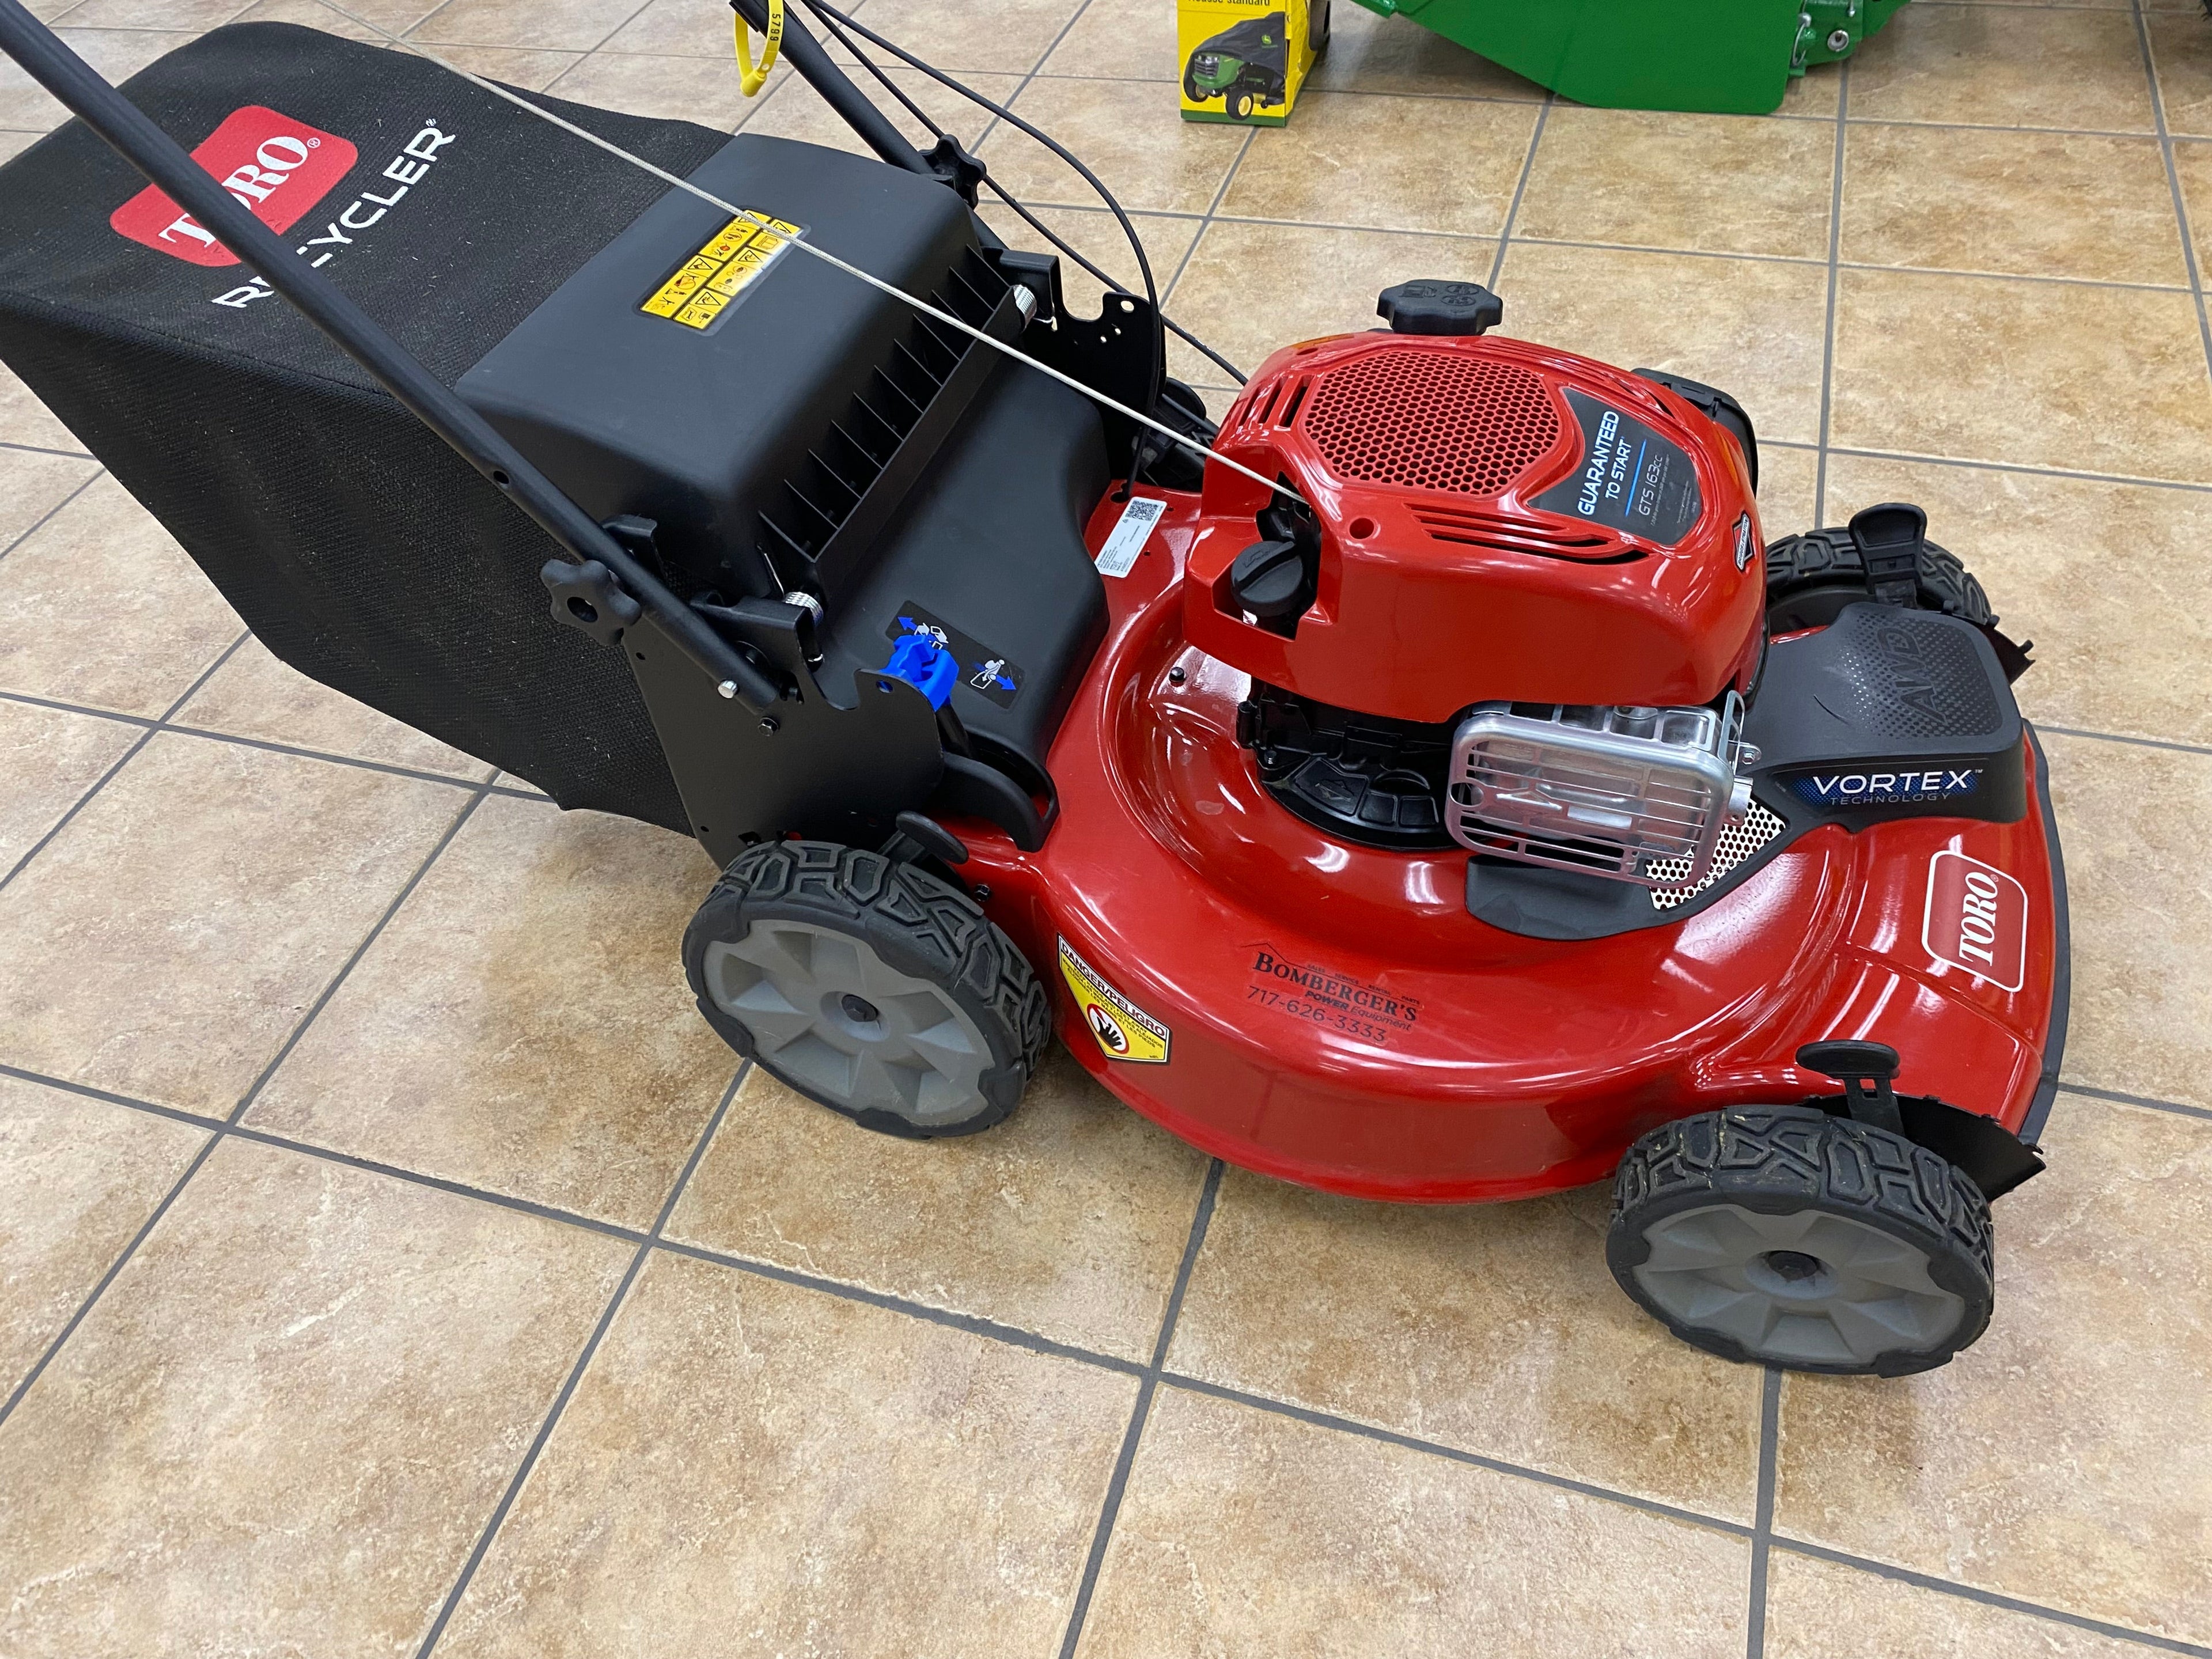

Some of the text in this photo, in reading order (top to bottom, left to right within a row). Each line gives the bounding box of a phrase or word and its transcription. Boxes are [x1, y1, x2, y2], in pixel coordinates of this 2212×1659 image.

[770, 13, 781, 41] 5799
[158, 136, 309, 248] TRO
[211, 126, 456, 308] RYCLER
[1578, 411, 1619, 516] GUARANTEED
[1605, 439, 1631, 499] TO START
[1645, 454, 1662, 487] 163cc
[1638, 488, 1654, 516] GTS
[1877, 627, 1948, 726] AWD
[1813, 770, 1972, 795] VORTEX
[1831, 792, 1950, 806] TECHNOLOGY
[1959, 872, 1998, 967] TORO
[1062, 942, 1165, 1037] DANGER/PELIGRO
[1248, 986, 1386, 1041] 717-626-3333
[1252, 951, 1416, 1021] BOMBERGER'S
[1305, 991, 1411, 1031] POWER Equipment
